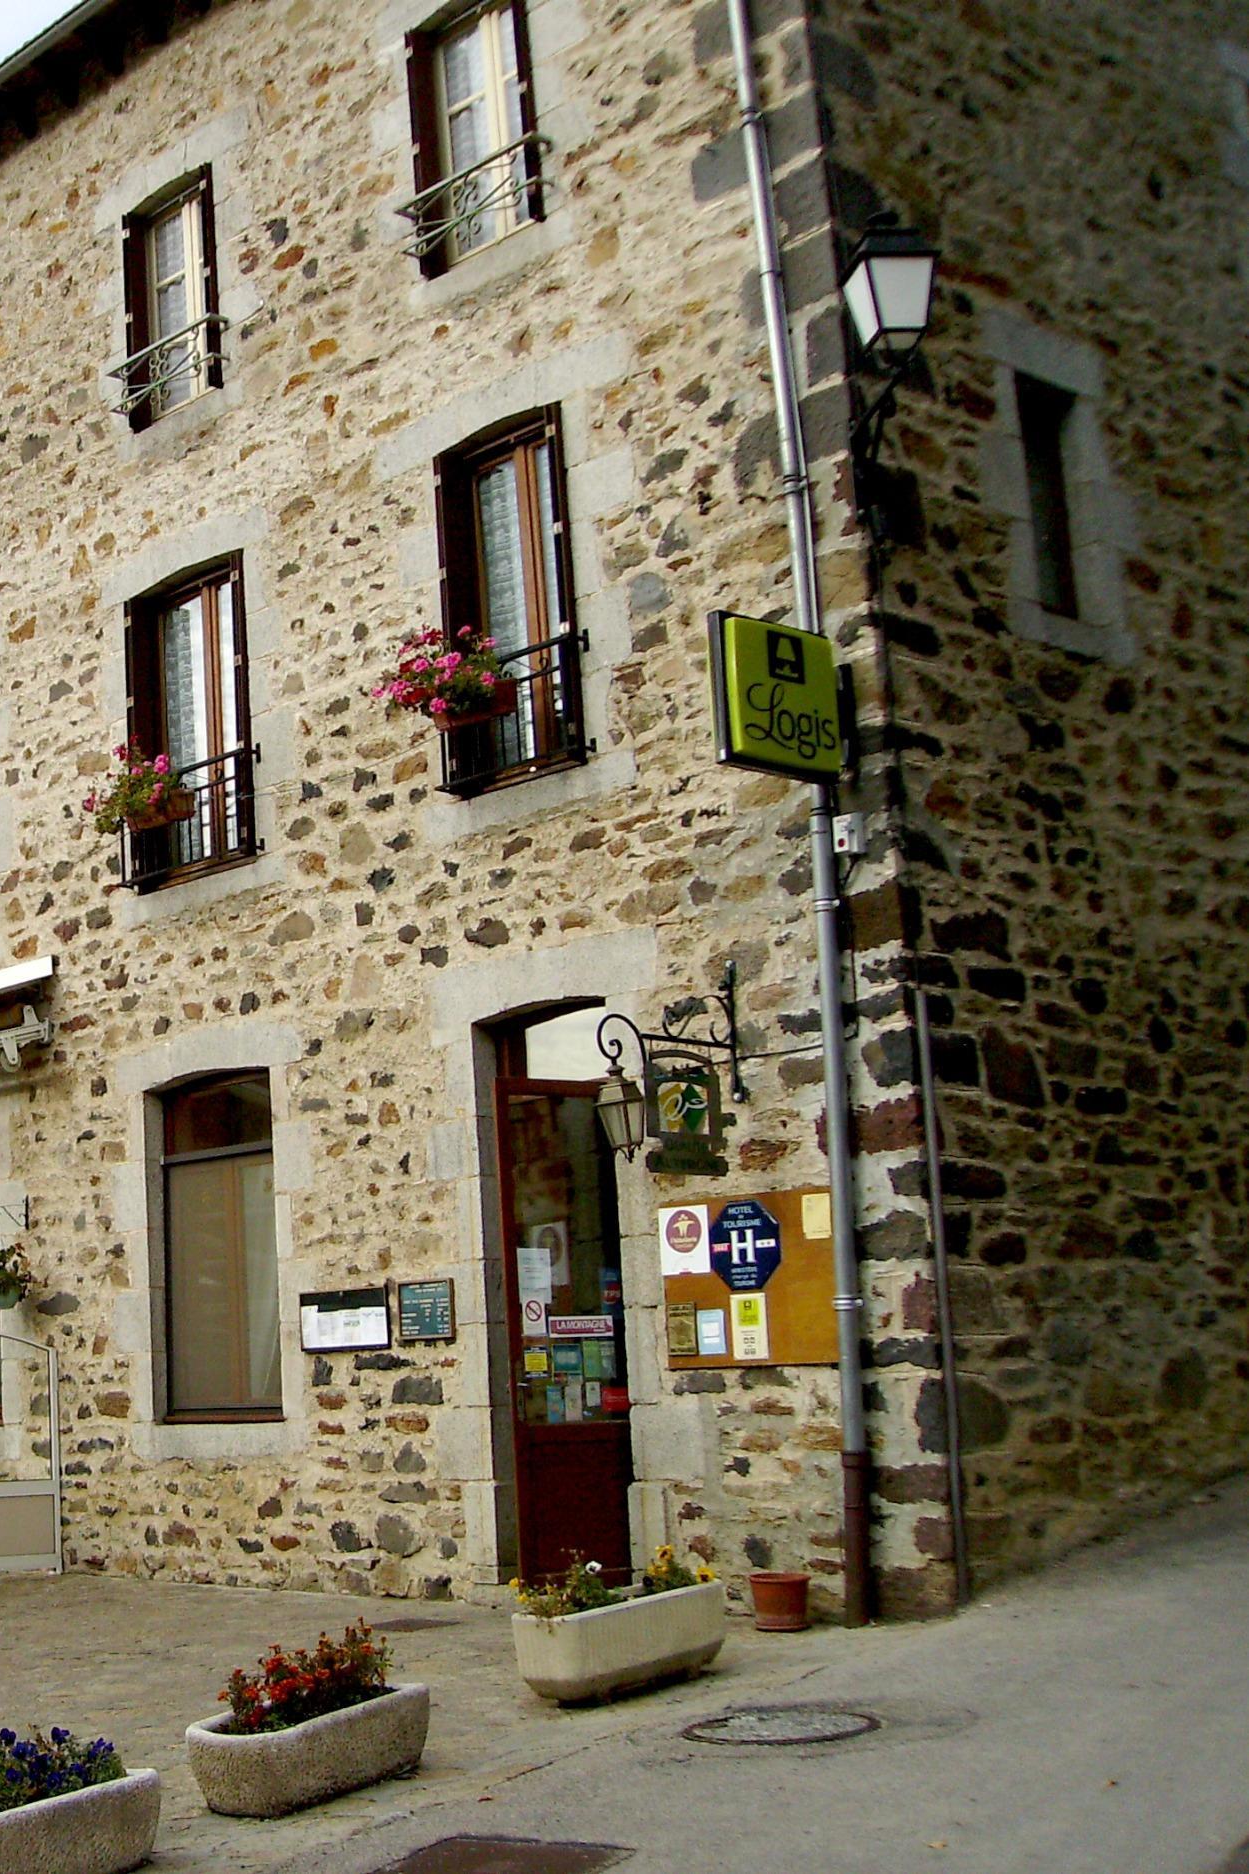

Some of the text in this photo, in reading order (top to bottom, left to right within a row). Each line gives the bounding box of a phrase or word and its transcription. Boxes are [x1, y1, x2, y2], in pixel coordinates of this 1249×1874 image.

[744, 683, 836, 760] Logis
[728, 1206, 753, 1214] HOTEL
[723, 1219, 762, 1228] TOURISME
[730, 1229, 756, 1264] H
